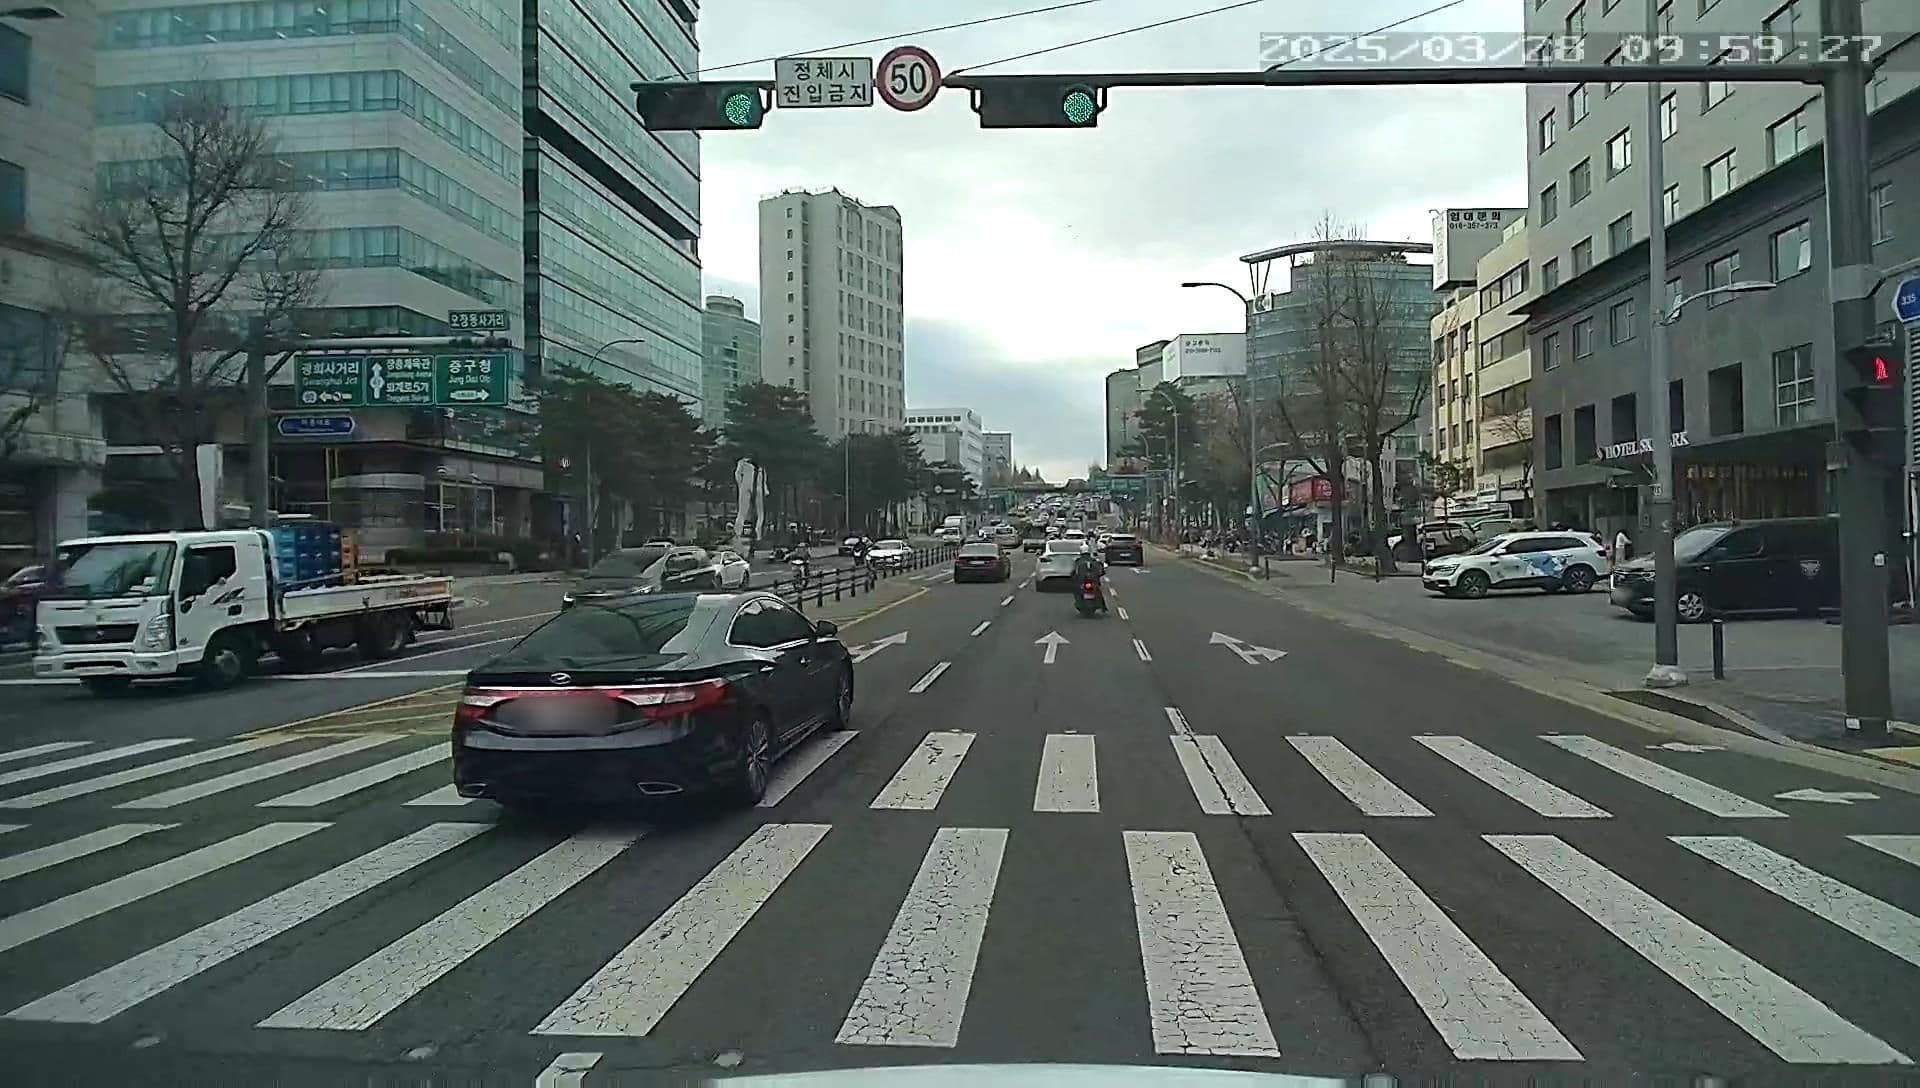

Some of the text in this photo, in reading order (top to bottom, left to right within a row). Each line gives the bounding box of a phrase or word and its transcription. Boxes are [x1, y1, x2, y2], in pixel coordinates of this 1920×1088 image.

[890, 62, 927, 95] 50
[783, 83, 867, 103] 진입금지
[450, 313, 505, 328] 오장동사거리
[302, 361, 359, 376] 광희사거리
[386, 358, 431, 370] 장충체육관
[449, 359, 491, 374] 중구청
[386, 381, 430, 393] 퇴계로5가
[1605, 441, 1638, 459] HOTEL
